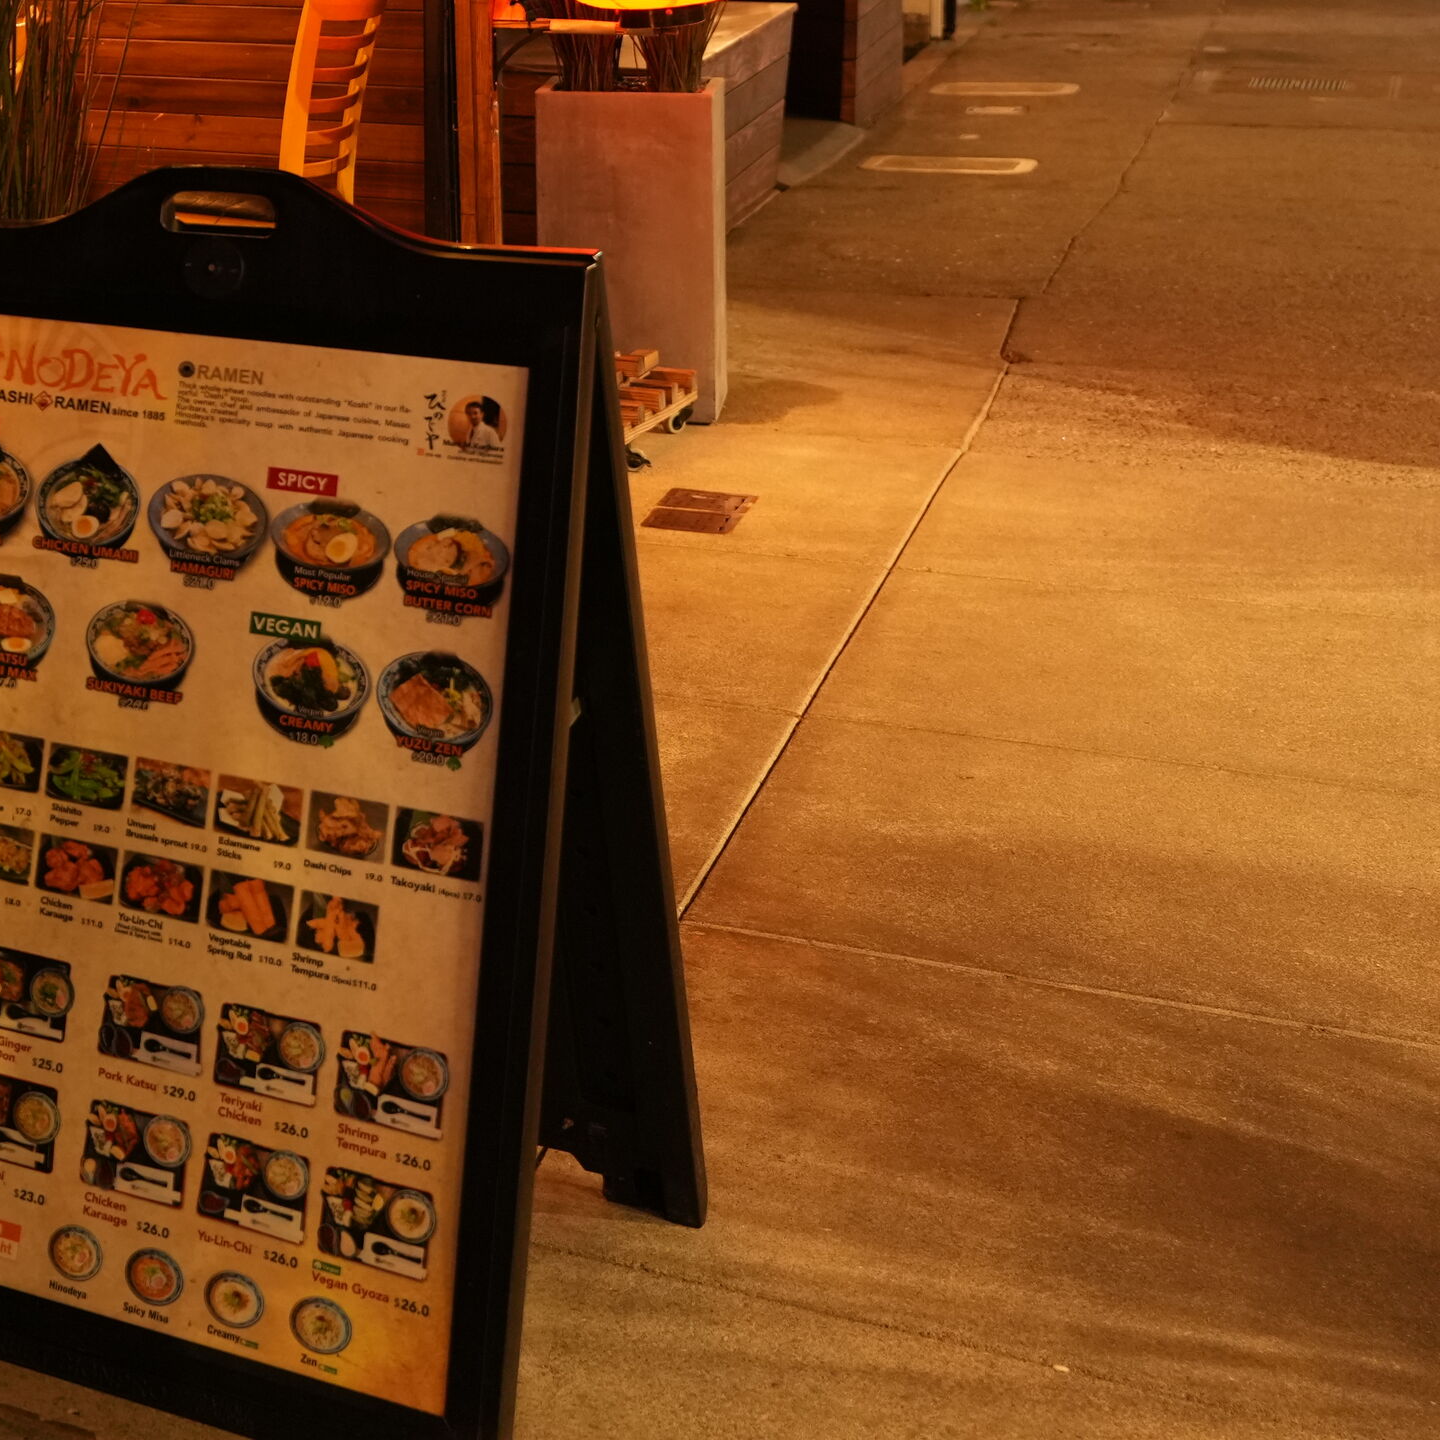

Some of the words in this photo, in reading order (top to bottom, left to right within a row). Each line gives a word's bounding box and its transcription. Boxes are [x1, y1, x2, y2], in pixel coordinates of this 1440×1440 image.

[197, 365, 264, 385] RAMEN
[54, 397, 111, 414] RAMEN
[112, 408, 138, 418] since
[277, 472, 328, 491] SPICY
[33, 536, 89, 555] CHICKEN
[92, 543, 138, 562] UMAMI
[171, 562, 235, 580] HAMAGURI
[318, 569, 351, 582] Popular
[293, 577, 325, 592] SPICY
[327, 582, 356, 595] MISO
[406, 580, 441, 594] SPICY
[444, 586, 478, 600] MISO
[404, 594, 451, 610] BUTTER
[455, 602, 492, 617] CORN
[254, 616, 318, 639] VEGAN
[86, 677, 147, 699] SUKIYAKI
[149, 689, 182, 704] BEEF
[279, 715, 334, 732] CREAMY
[396, 735, 432, 752] YUZU
[434, 743, 462, 756] ZEN
[52, 802, 82, 816] Shishito
[50, 814, 78, 828] Pepper
[127, 818, 156, 832] Umami
[219, 836, 260, 853] Edamame
[217, 847, 242, 861] Sticks
[304, 859, 326, 871] Dashi
[328, 865, 352, 877] Chips
[391, 875, 435, 893] Takoyaki
[40, 896, 72, 910] Chicken
[40, 907, 74, 922] Karaage
[118, 912, 163, 930] Yu-Lin-Chi
[209, 933, 251, 950] Vegetable
[207, 945, 234, 961] Spring
[236, 951, 252, 961] Roll
[292, 952, 323, 968] Shrimp
[291, 964, 329, 981] Tempura
[32, 1057, 63, 1073] $25.0
[98, 1067, 123, 1082] Pork
[126, 1073, 157, 1092] Katsu
[162, 1085, 196, 1102] $29.0
[220, 1092, 262, 1113] Teriyaki
[218, 1107, 262, 1126] Chicken
[274, 1121, 308, 1139] $26.0
[338, 1123, 379, 1143] Shrimp
[336, 1137, 387, 1159] Tempura
[395, 1152, 431, 1171] $26.0
[14, 1188, 45, 1205] $23.0
[84, 1191, 126, 1212] Chicken
[82, 1205, 127, 1227] Karaage
[136, 1221, 169, 1239] $26.0
[198, 1229, 252, 1255] Yu-Lin-Chi
[263, 1250, 298, 1268] $26.0
[48, 1280, 87, 1300] Hinodeya
[312, 1270, 348, 1290] Vegan
[352, 1283, 389, 1303] Gyoza
[394, 1297, 429, 1317] $26.0
[123, 1302, 147, 1320] Spicy
[148, 1309, 169, 1324] Miso
[207, 1324, 241, 1344] Creamy
[300, 1353, 318, 1368] Zen
